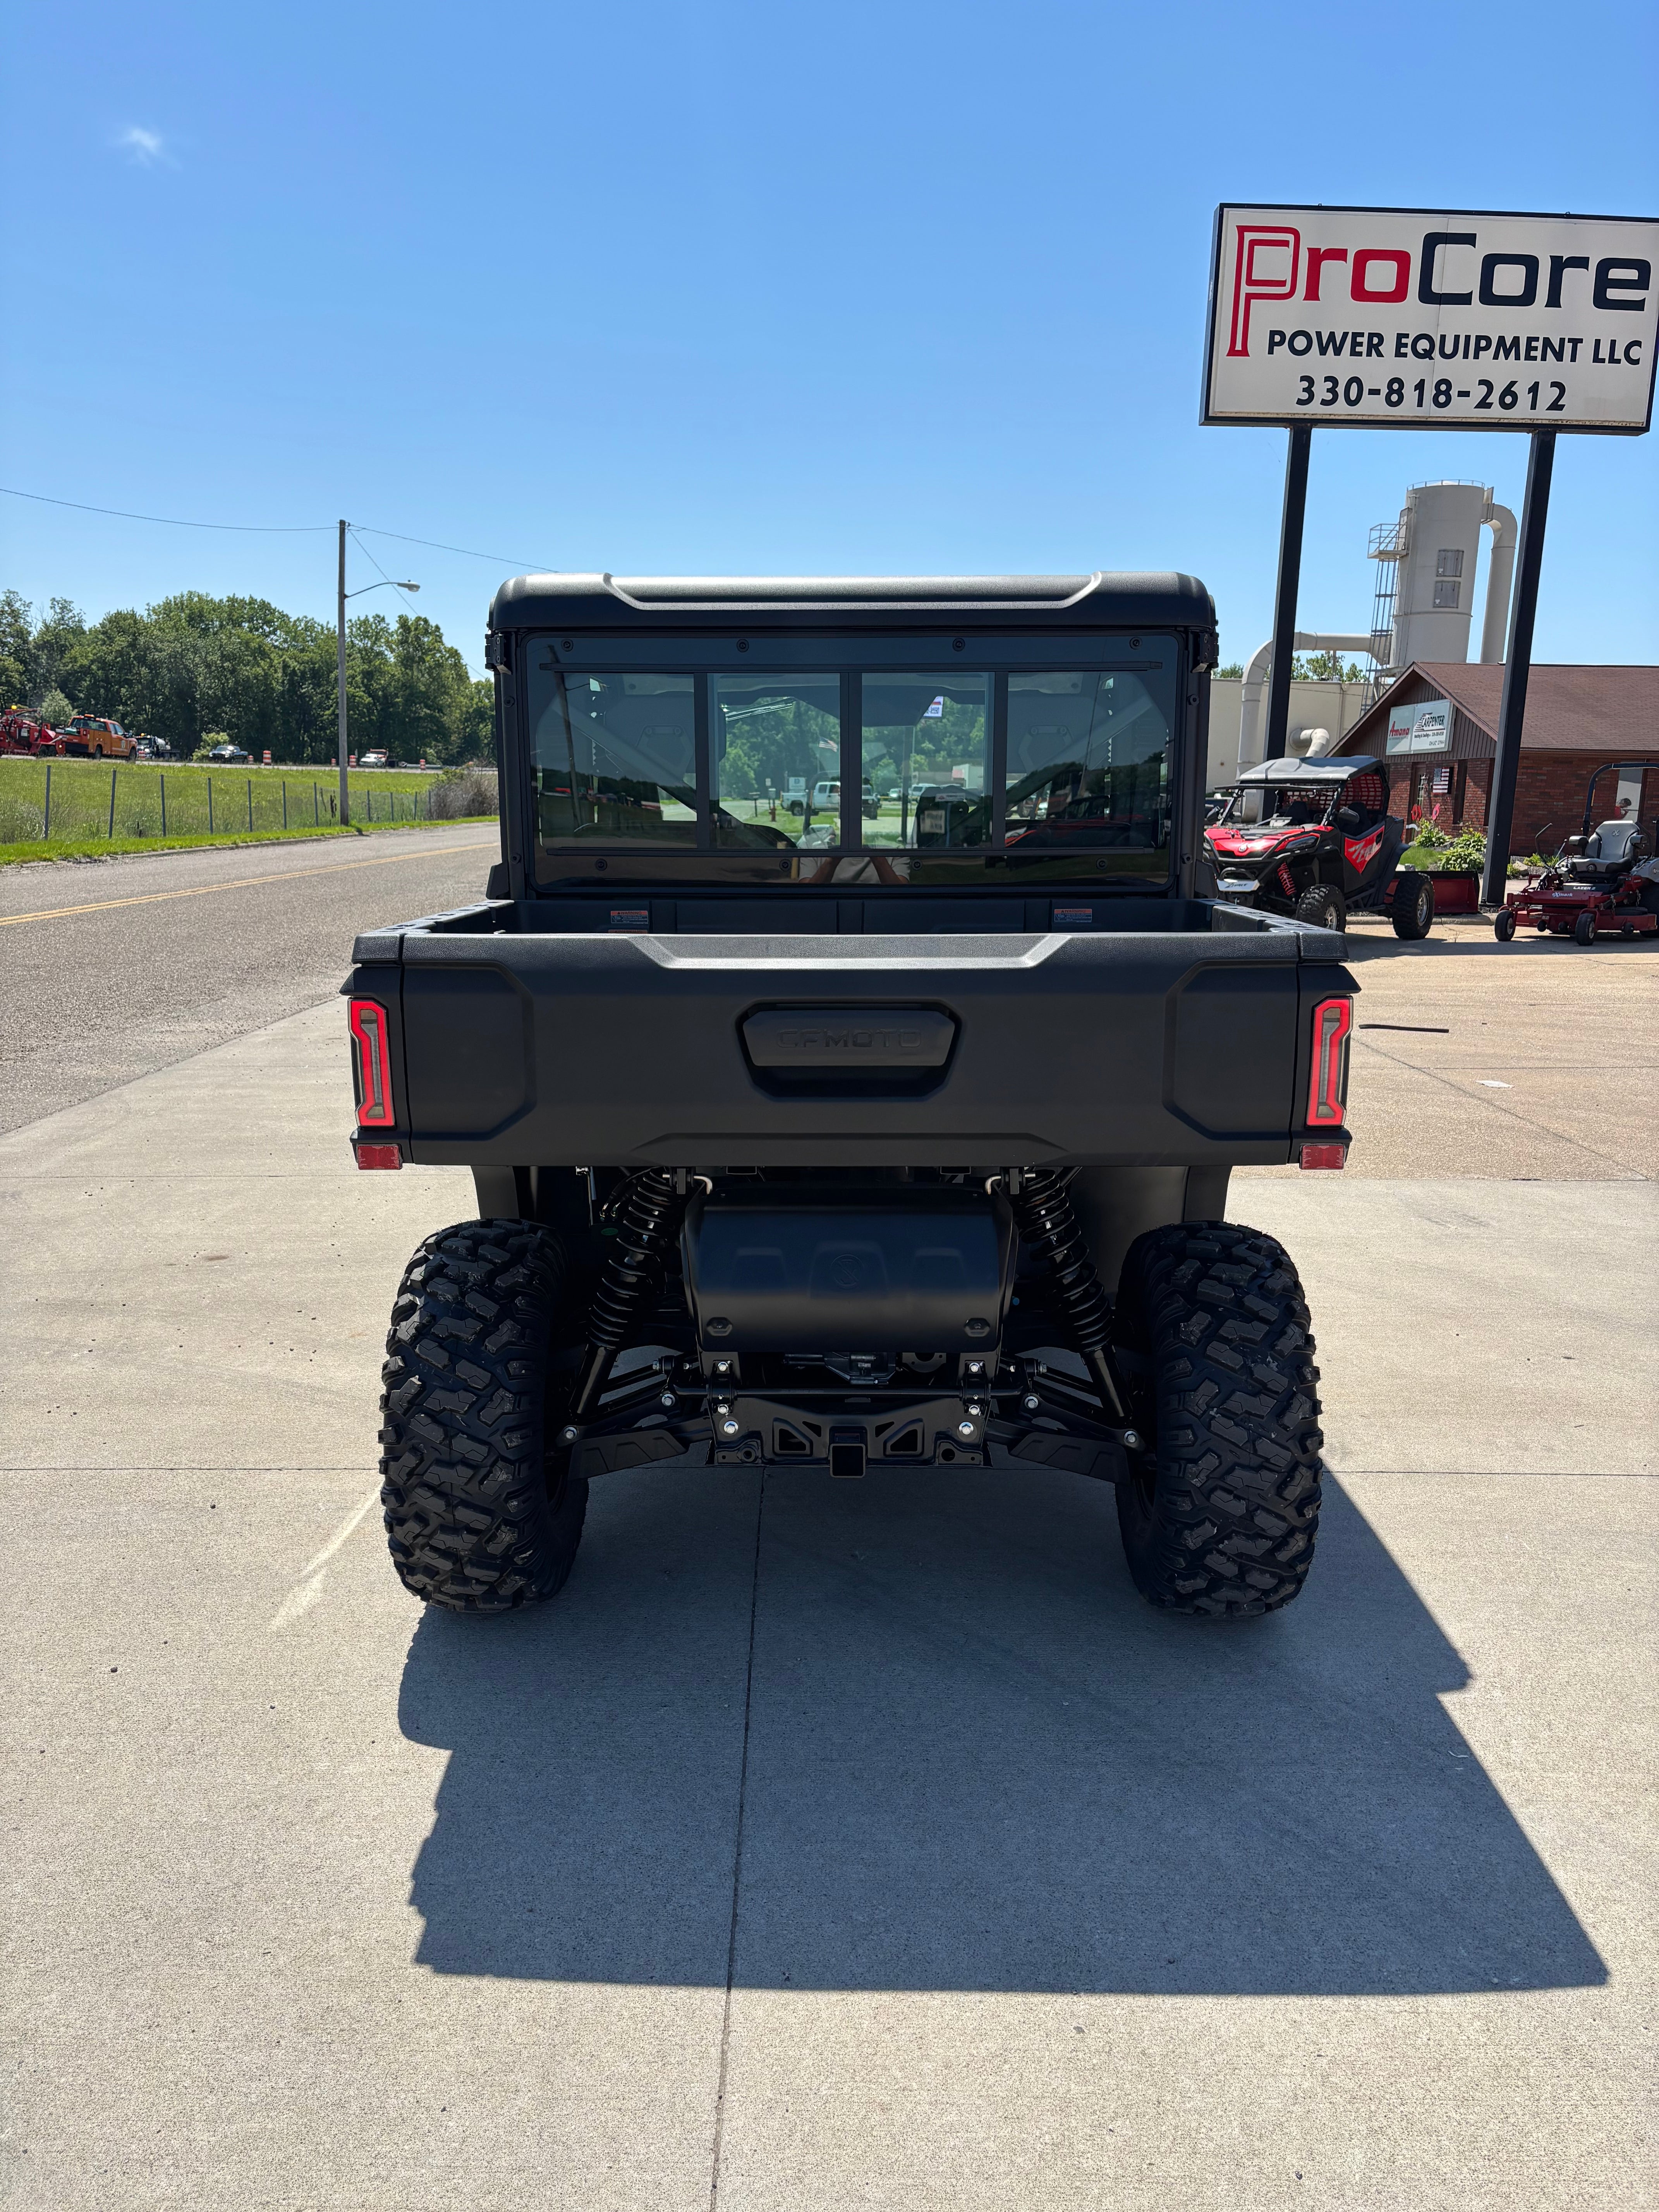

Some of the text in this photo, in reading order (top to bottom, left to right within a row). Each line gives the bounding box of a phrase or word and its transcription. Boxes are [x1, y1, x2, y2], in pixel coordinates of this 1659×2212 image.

[1226, 225, 1651, 357] ProCore
[1267, 330, 1643, 365] POWER EQUIPMENT LLC
[1296, 375, 1566, 411] 330-818-2612
[1389, 721, 1410, 737] Amana
[1421, 715, 1445, 728] CARPENTER
[777, 1029, 922, 1048] CFMOTO
